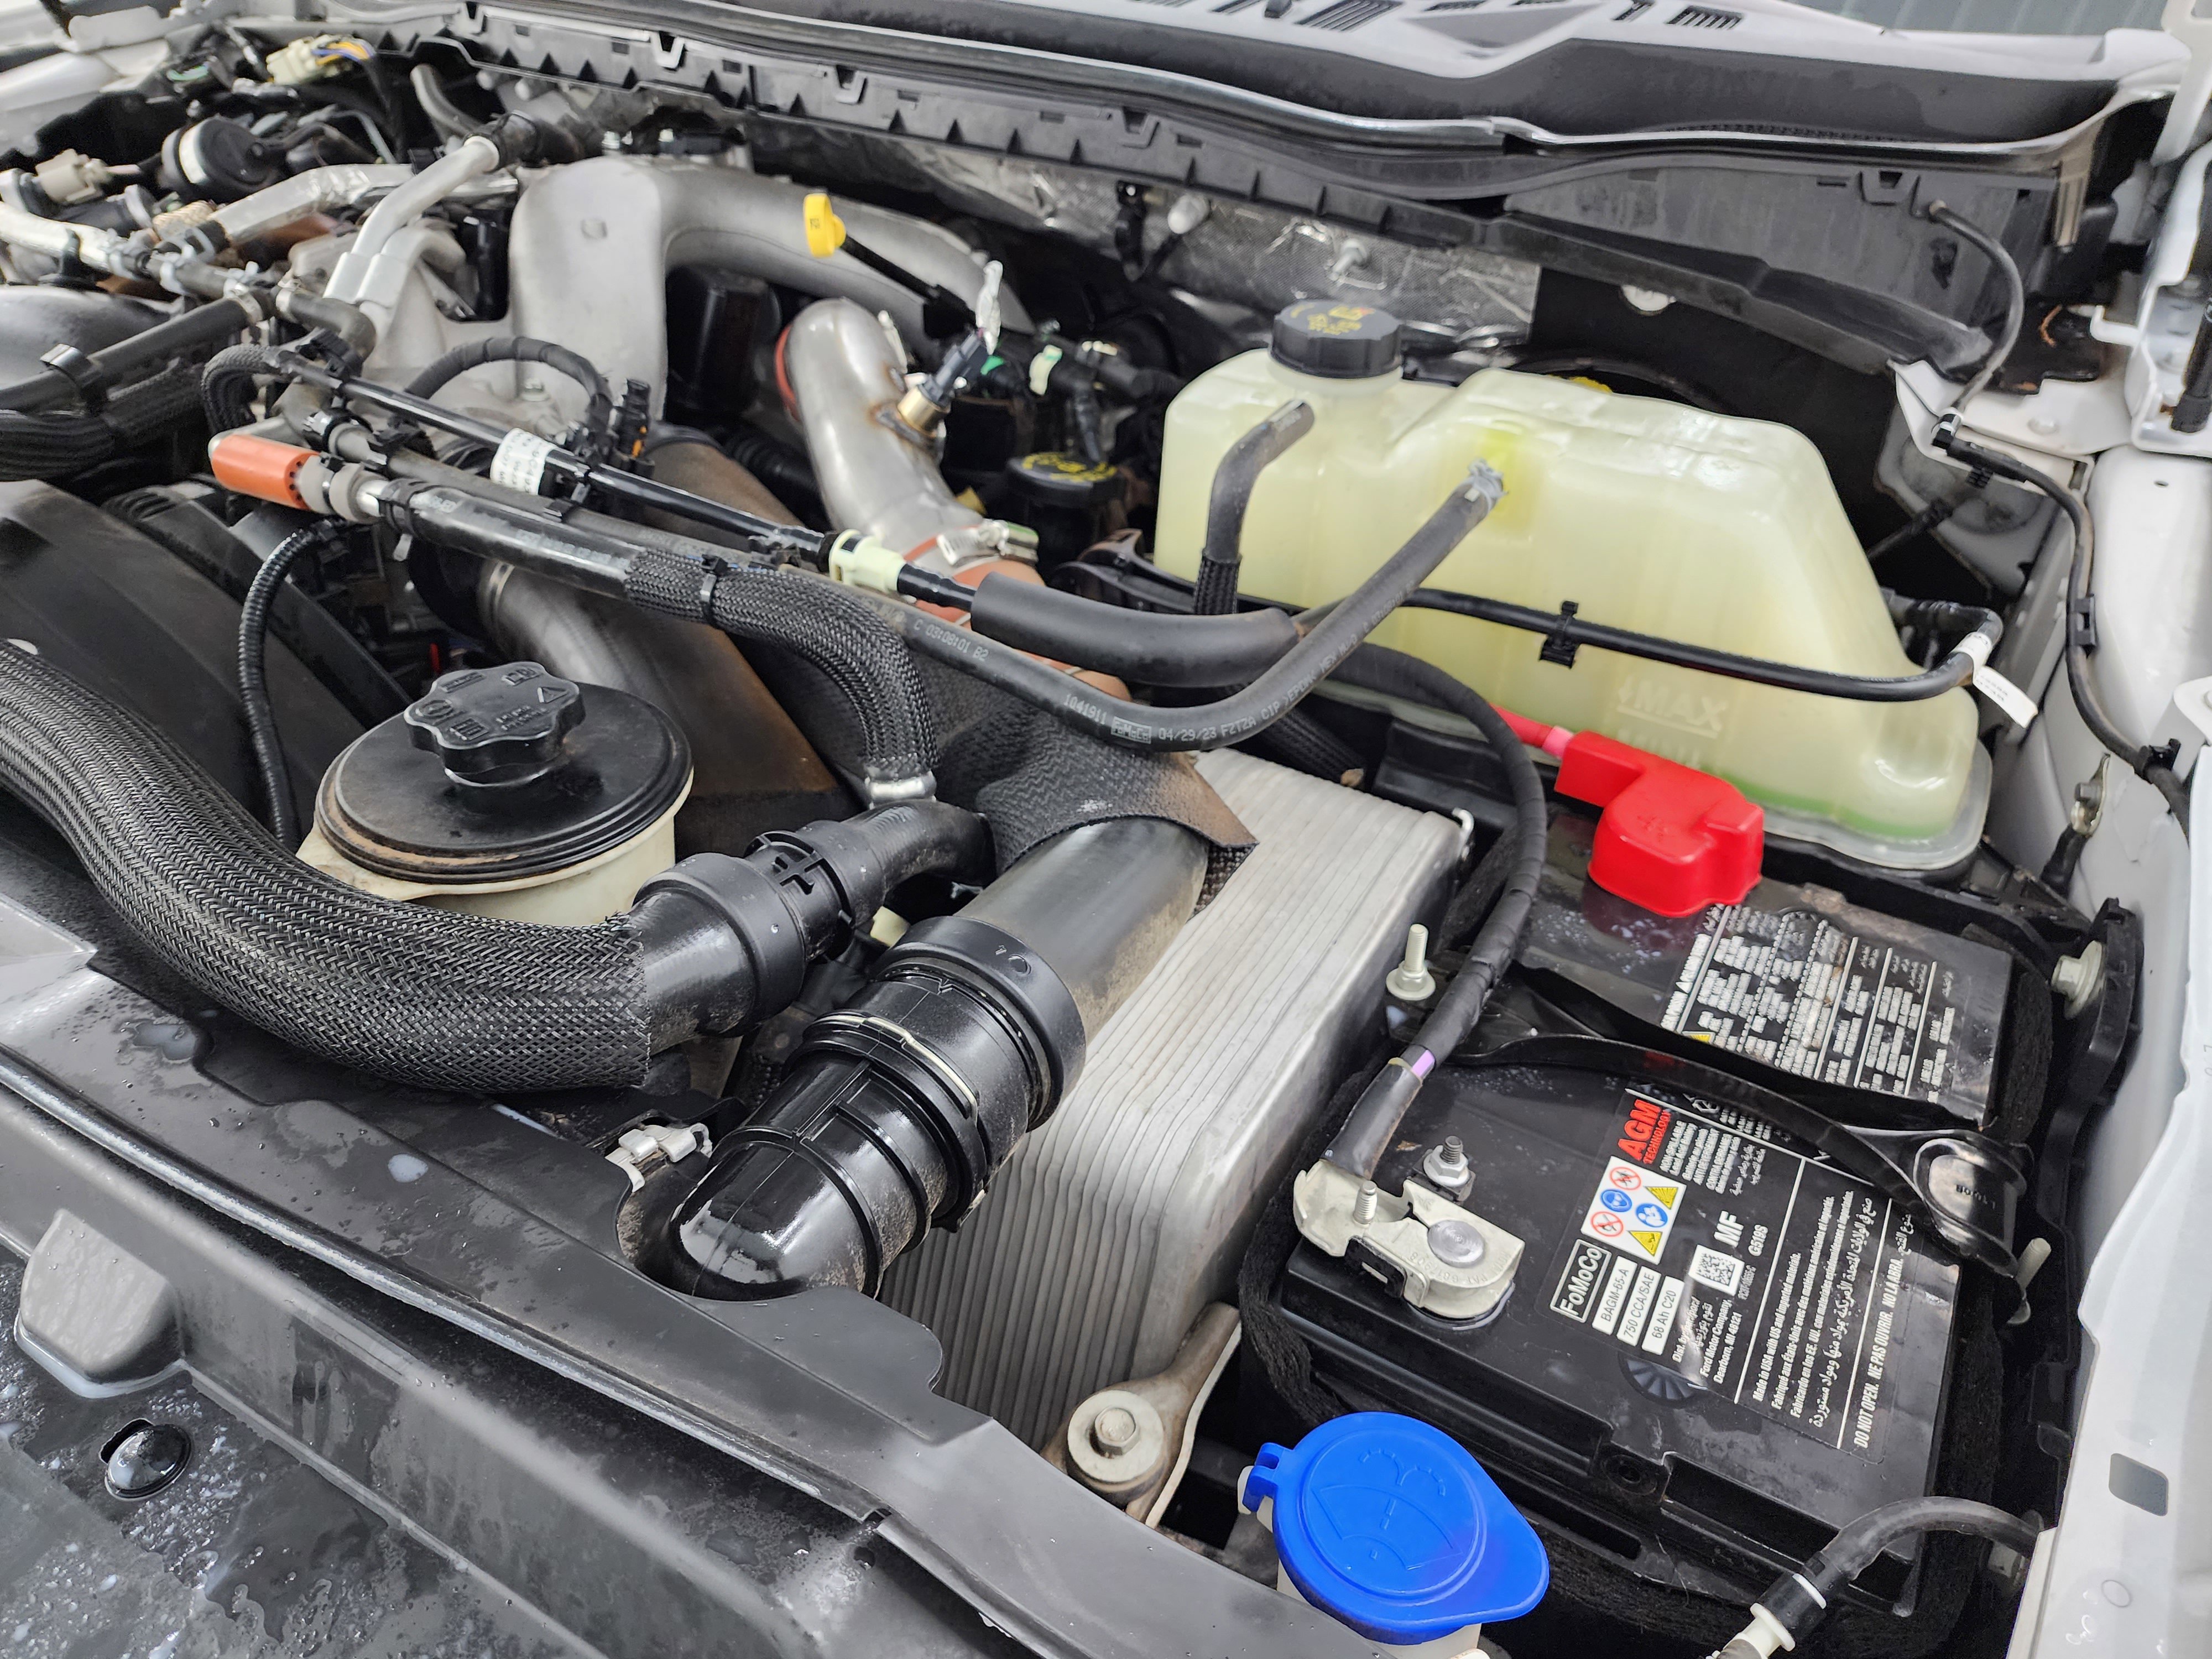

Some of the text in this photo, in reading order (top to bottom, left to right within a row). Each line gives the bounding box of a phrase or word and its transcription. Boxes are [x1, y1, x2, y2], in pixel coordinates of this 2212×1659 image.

[1634, 679, 1728, 732] MAX
[1158, 727, 1217, 742] 04/29/23
[1618, 1100, 1660, 1160] AGM
[1643, 1110, 1670, 1163] TECHNOLOGY
[1714, 1211, 1743, 1246] MF
[1748, 1224, 1767, 1256] G519S
[1818, 1222, 1828, 1231] et
[1560, 1248, 1602, 1315] FoMoCo
[1601, 1268, 1629, 1322] BAGM-65-A
[1802, 1263, 1817, 1296] matériaux
[1817, 1279, 1833, 1315] materiales
[1624, 1273, 1655, 1338] 750 CCA/SAE
[1652, 1290, 1676, 1339] 68 Ah C20
[1794, 1308, 1806, 1326] avec
[1797, 1295, 1809, 1310] des
[1808, 1198, 1876, 1427] صنع في الولايات المتحدة الأمريكية بمواد منها ومواد مستوردة
[1752, 1253, 1801, 1401] Made in USA with US and imported materials.
[1808, 1329, 1820, 1342] UU.
[1813, 1313, 1824, 1328] con
[1672, 1339, 1686, 1363] Dist.
[1699, 1300, 1732, 1377] Ford Motor Company,
[1713, 1312, 1742, 1384] Dearborn, MI 48121
[1781, 1325, 1802, 1363] États-Unis
[1805, 1343, 1817, 1355] EE.
[1854, 1259, 1903, 1448] DO NOT OPEN. NE PAS OUVRIR. NO LA ABRA.
[1781, 1361, 1792, 1376] aux
[1802, 1354, 1814, 1368] los
[1802, 1366, 1811, 1378] en
[1771, 1375, 1788, 1409] Fabriqué
